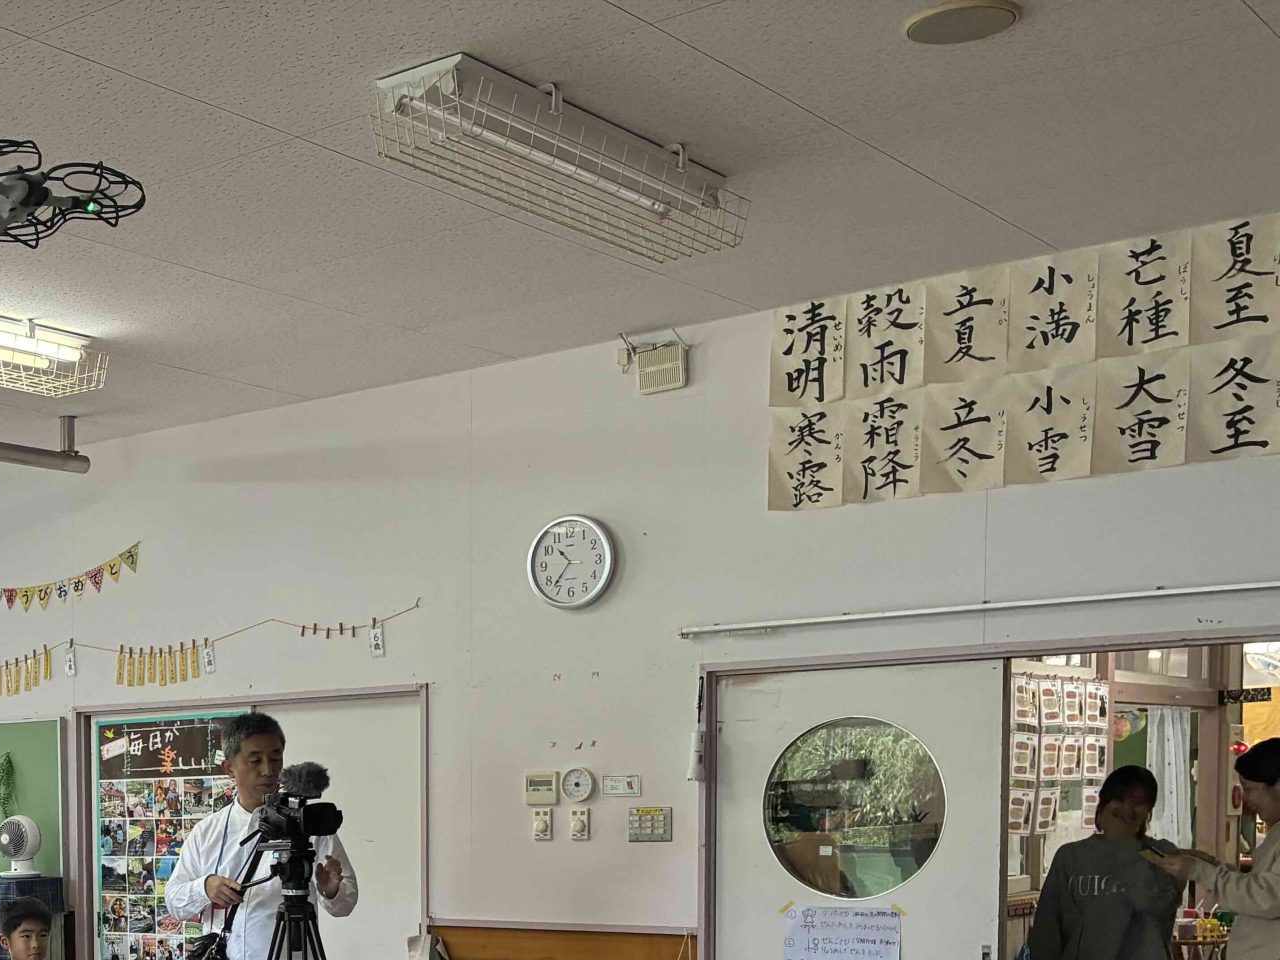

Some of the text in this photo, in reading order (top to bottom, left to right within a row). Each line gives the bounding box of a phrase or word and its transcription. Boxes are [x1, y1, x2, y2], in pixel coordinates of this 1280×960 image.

[1117, 239, 1178, 346] 芒種
[1212, 221, 1275, 329] 夏至
[1027, 266, 1080, 349] 小満
[1085, 274, 1095, 323] しょうまん
[832, 321, 842, 362] せいめい
[857, 288, 919, 388] 穀雨
[943, 285, 996, 363] 立夏
[783, 302, 836, 402] 清明
[1079, 397, 1090, 442] しょうせつ
[1115, 366, 1173, 463] 大雪
[1176, 389, 1187, 432] だいせつ
[1208, 357, 1271, 454] 冬至
[834, 432, 843, 463] かんろ
[860, 397, 914, 500] 霜降
[936, 397, 994, 478] 立冬
[1026, 386, 1071, 474] 小雪
[784, 411, 834, 508] 寒露
[544, 545, 553, 556] 10
[553, 533, 561, 544] 11
[565, 527, 575, 538] 12
[582, 530, 586, 540] 1
[590, 539, 597, 550] 2
[540, 561, 548, 572] 9
[590, 569, 597, 580] 4
[595, 554, 602, 564] 3
[545, 575, 553, 586] 8
[555, 585, 562, 596] 7
[567, 587, 575, 598] 6
[581, 582, 588, 593] 5
[129, 721, 180, 756] 毎日が
